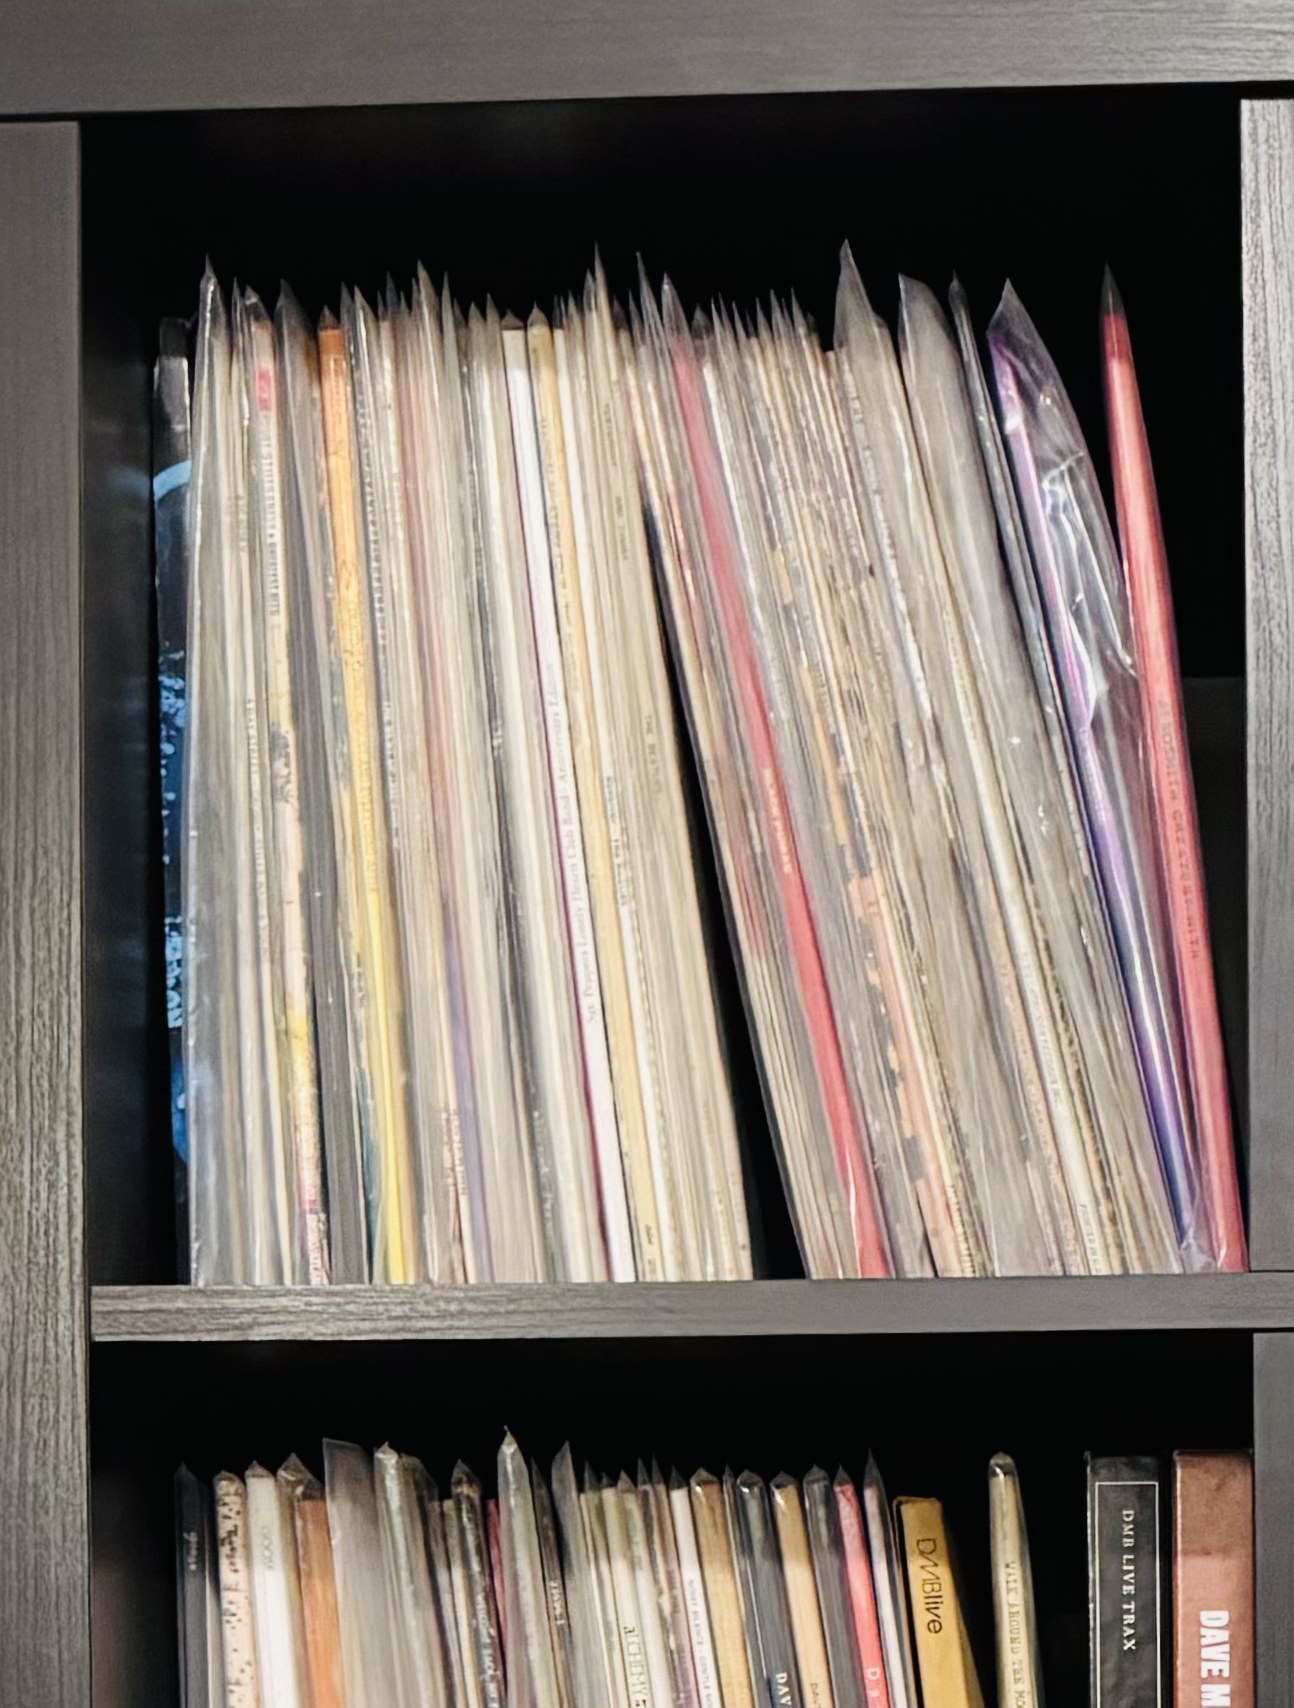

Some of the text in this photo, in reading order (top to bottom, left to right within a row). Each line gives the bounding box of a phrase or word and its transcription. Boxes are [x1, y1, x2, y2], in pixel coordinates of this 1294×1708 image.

[1004, 1560, 1019, 1595] WALK
[1122, 1510, 1136, 1651] DMB LIVE TRAX
[1007, 1602, 1023, 1655] AROUND
[1200, 1610, 1230, 1677] DAVE
[1012, 1659, 1025, 1685] THE
